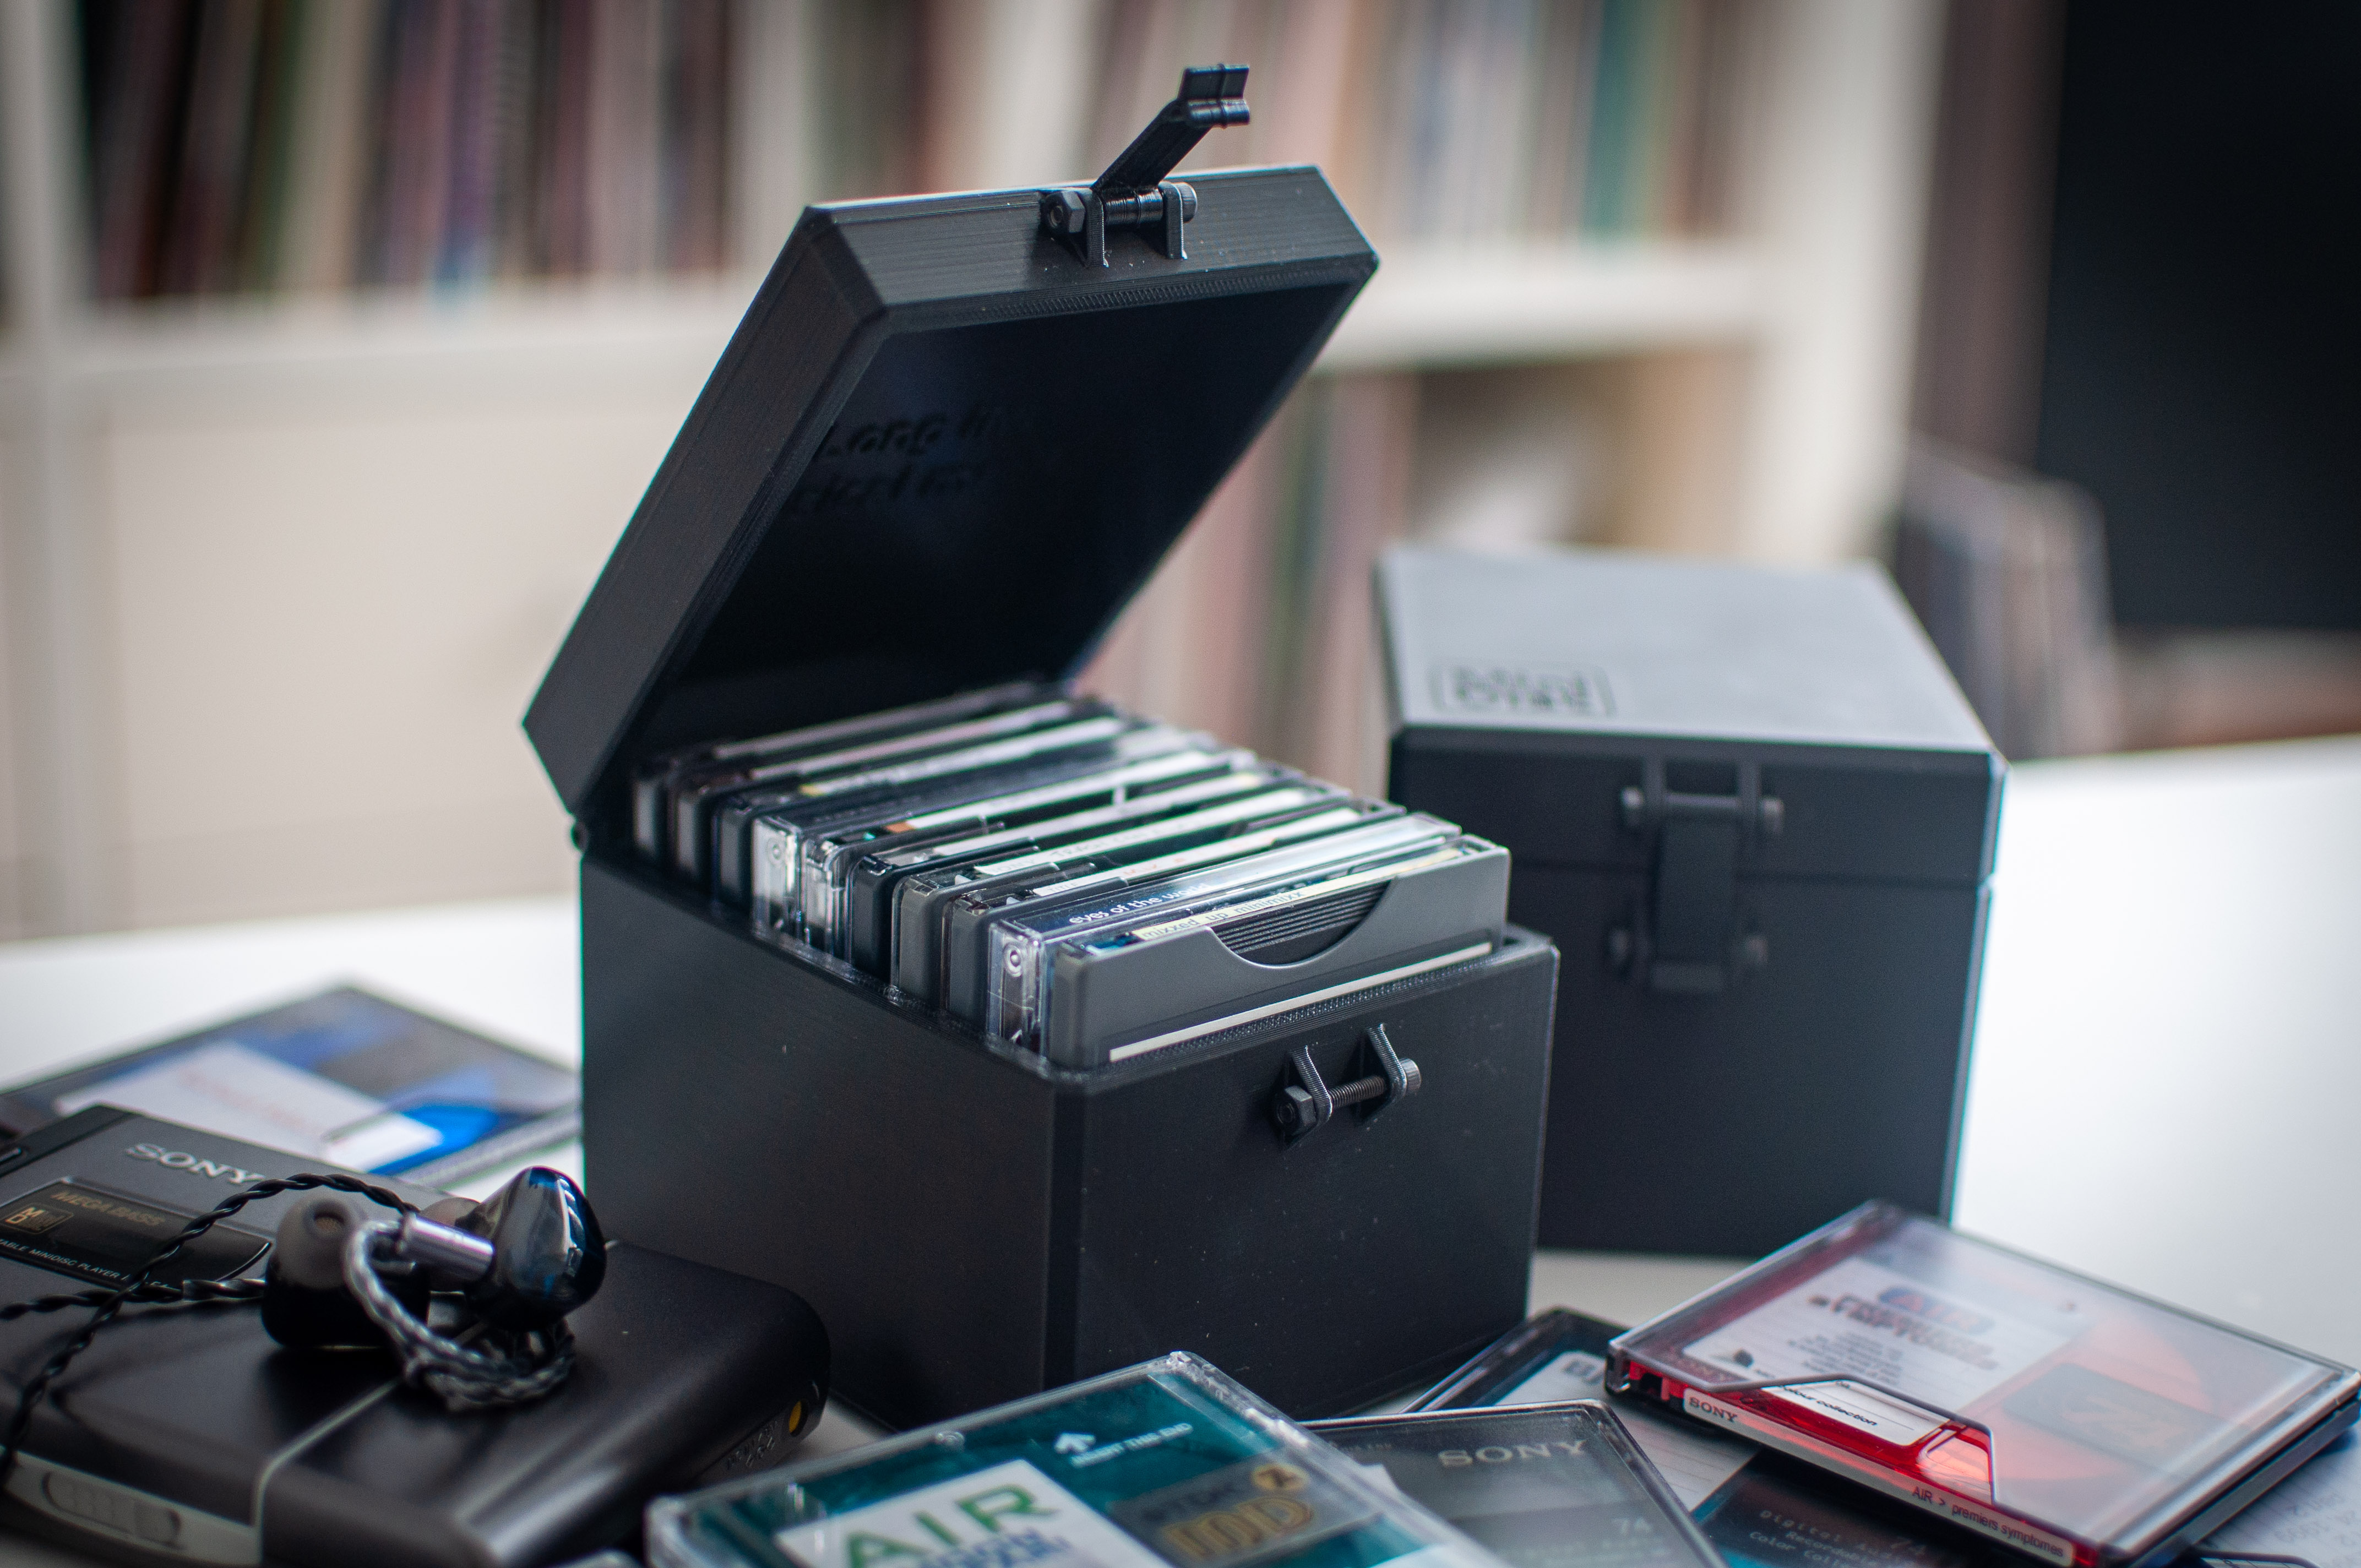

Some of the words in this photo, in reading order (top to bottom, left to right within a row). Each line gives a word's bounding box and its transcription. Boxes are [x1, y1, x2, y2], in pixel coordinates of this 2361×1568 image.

[1068, 912, 1109, 924] eyes
[1109, 904, 1130, 914] of
[1128, 897, 1163, 910] the
[1141, 918, 1199, 939] mixxed
[1205, 911, 1229, 923] up
[1235, 890, 1305, 914] minimixx
[126, 1144, 265, 1184] SONY
[51, 1190, 112, 1212] MEGA
[108, 1206, 166, 1227] BASS
[28, 1248, 77, 1266] MINIDISC
[77, 1262, 120, 1278] PLAYER
[1689, 1397, 1737, 1423] SONY
[1816, 1398, 1877, 1426] collection
[1438, 1440, 1586, 1468] SONY
[848, 1485, 1058, 1568] AIR
[1759, 1510, 1841, 1542] Digital
[1912, 1486, 1933, 1504] AIR
[1951, 1504, 1999, 1531] premiers
[2000, 1523, 2064, 1558] symptomes
[1749, 1531, 1796, 1550] Color
